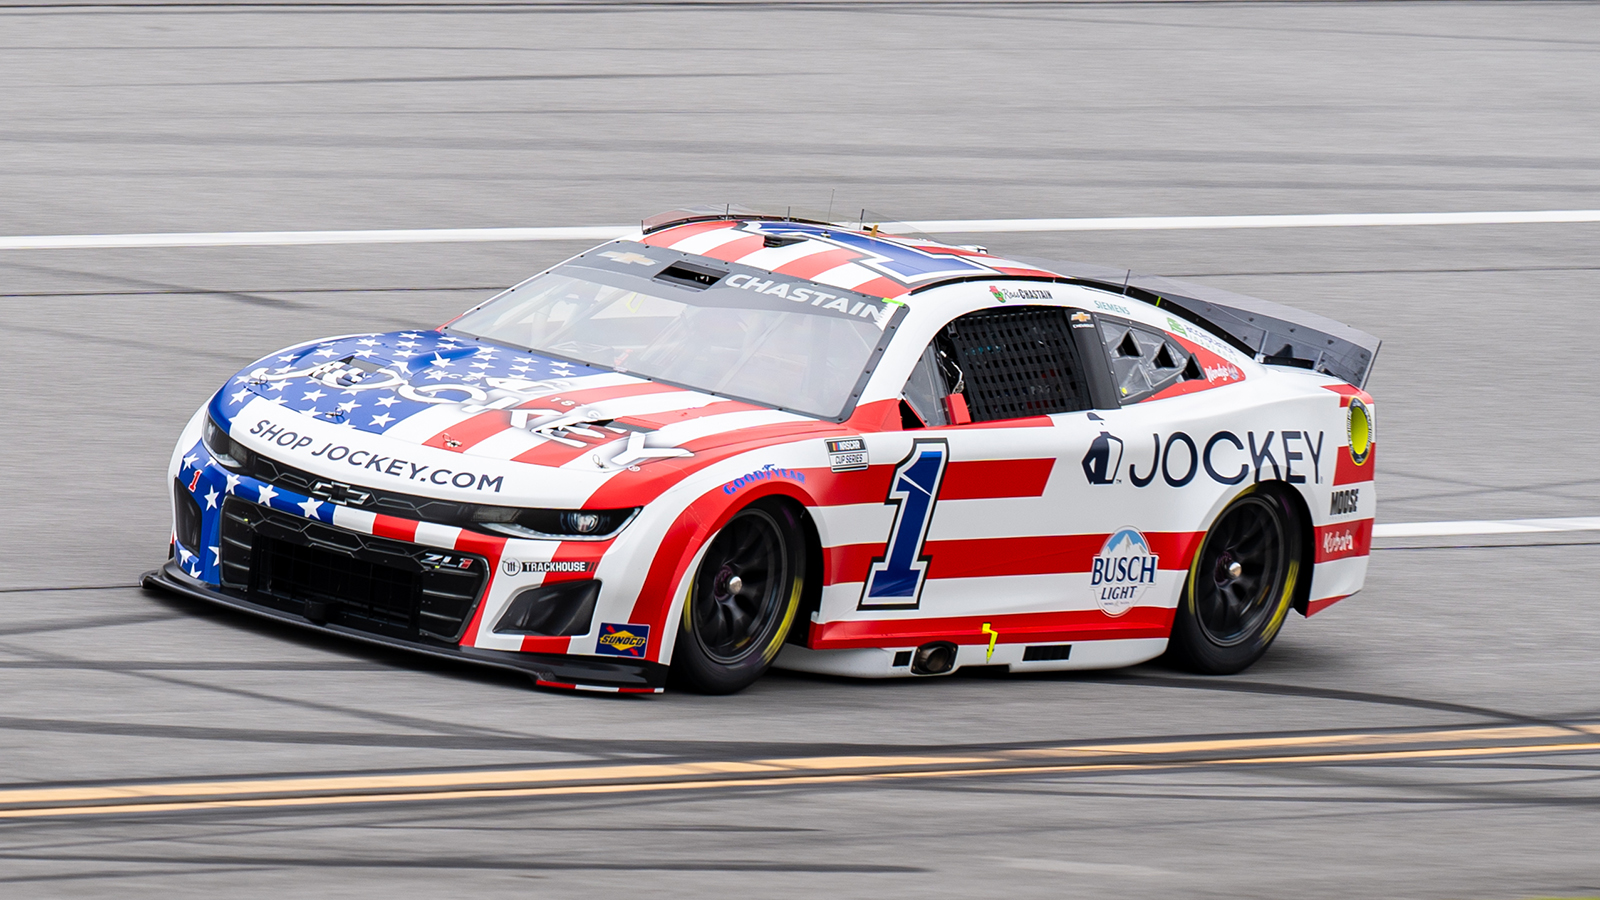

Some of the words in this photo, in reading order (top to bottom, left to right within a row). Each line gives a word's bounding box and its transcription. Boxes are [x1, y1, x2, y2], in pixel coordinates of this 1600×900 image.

[735, 221, 1004, 288] 1
[725, 273, 886, 322] CHASTAIN
[1018, 288, 1053, 299] CHASTAIN
[1094, 300, 1131, 315] SIEMENS
[250, 420, 312, 450] SHOP
[311, 443, 504, 493] JOCKEY.COM
[839, 440, 860, 450] NASCAR
[836, 455, 845, 464] CUP
[846, 453, 862, 463] SERIES
[1129, 431, 1324, 487] JOCKEY
[188, 469, 203, 493] 1
[723, 466, 806, 495] GOODYEAR
[1330, 489, 1359, 515] MOOSE
[856, 438, 949, 611] 1
[420, 552, 474, 569] ZL1
[525, 562, 586, 572] TRACKHOUSE
[1091, 556, 1156, 585] BUSCH
[1101, 586, 1137, 600] LIGHT
[601, 635, 644, 646] SUNOCO
